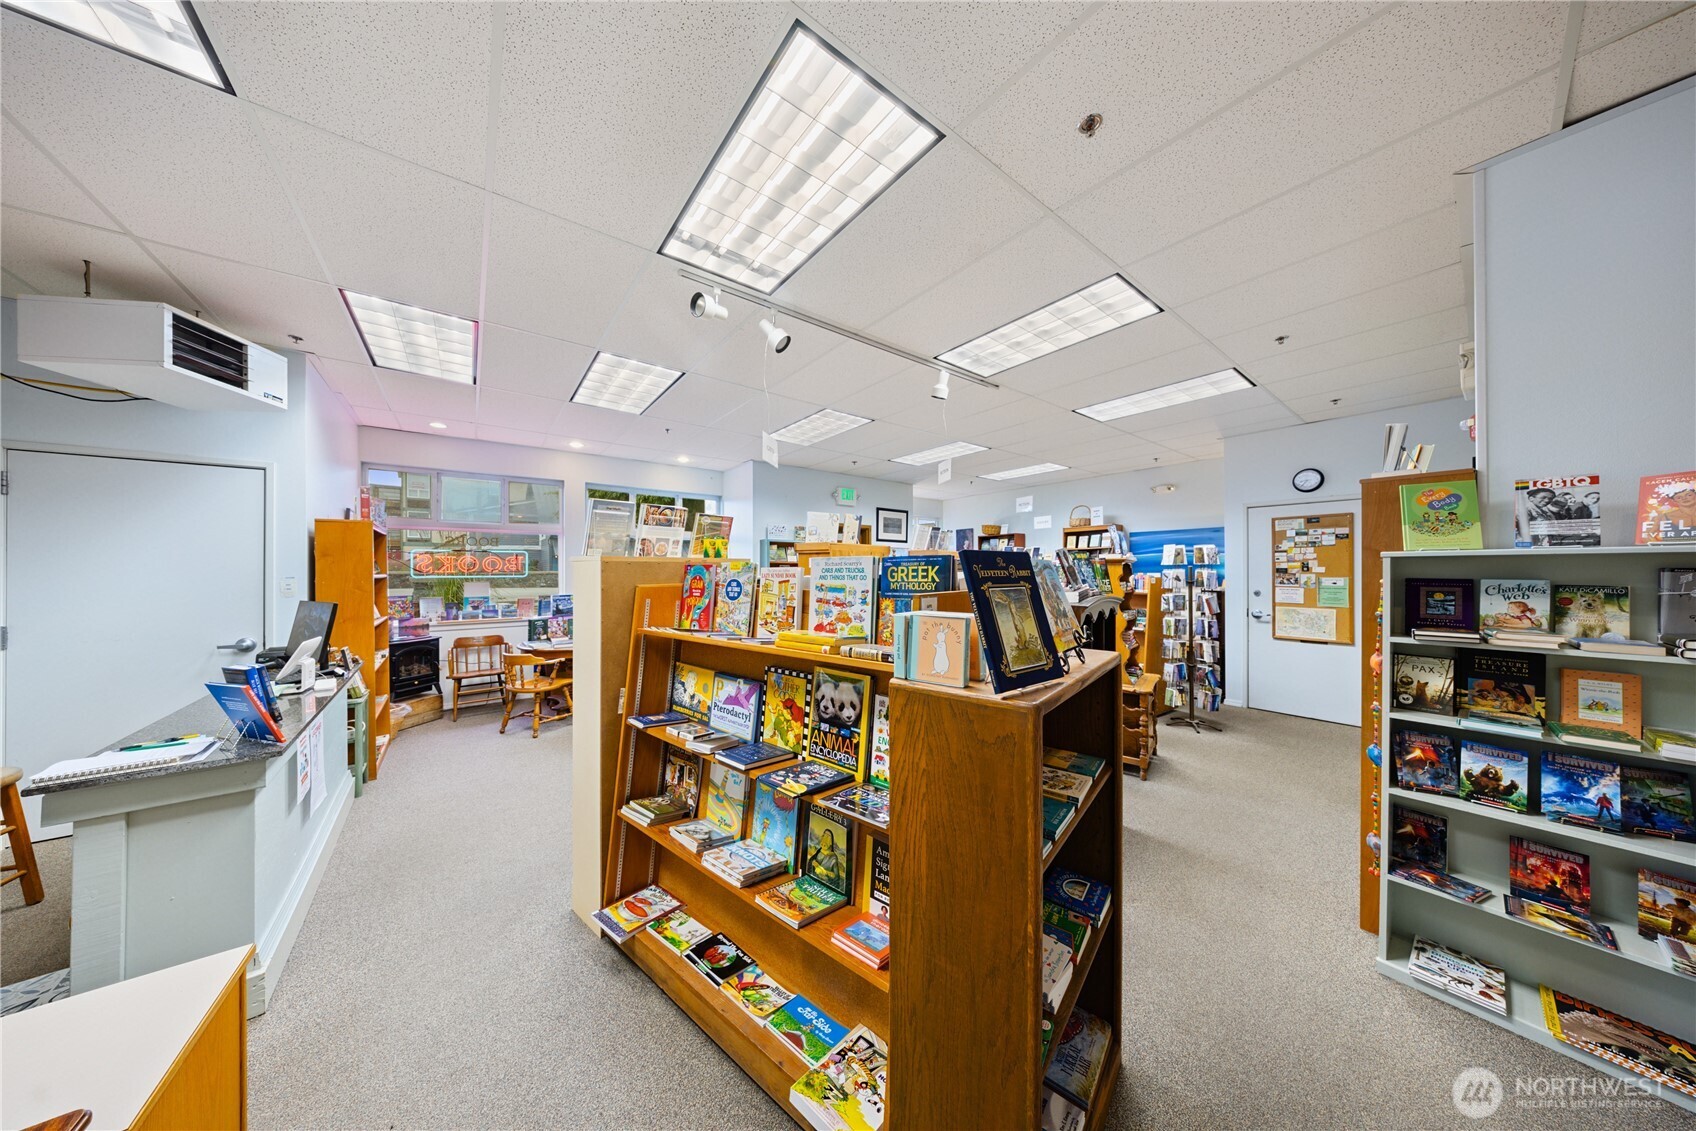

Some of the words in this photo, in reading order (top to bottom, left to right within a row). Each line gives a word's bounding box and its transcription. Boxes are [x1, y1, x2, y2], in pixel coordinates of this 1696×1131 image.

[1530, 476, 1590, 489] LGBTQ
[1421, 492, 1446, 502] Every
[1432, 497, 1456, 508] Body
[1642, 520, 1691, 532] FEL
[888, 566, 940, 582] GREEK
[890, 582, 936, 590] MYTHOLOGY
[1485, 583, 1548, 596] Charlotte's
[947, 622, 962, 644] bunny
[1412, 664, 1435, 674] PAX
[1474, 659, 1529, 668] TREASURE
[1475, 664, 1529, 673] ISLAND
[713, 702, 751, 723] Pterodactyl
[811, 730, 856, 757] ANIMAL
[878, 737, 889, 745] EN
[1411, 734, 1451, 746] SURVIVED
[810, 744, 856, 766] ENCYCLOPEDIA
[1473, 746, 1523, 762] SURVIVED
[1547, 752, 1552, 761] I
[1555, 755, 1613, 772] SURVIVED
[810, 804, 843, 823] GALLERY
[1404, 812, 1443, 826] SURVIVED
[724, 844, 772, 868] KNOTS
[876, 846, 889, 858] Am
[1523, 840, 1528, 849] I
[1529, 842, 1584, 864] SURVIVED
[876, 857, 889, 871] Sig
[875, 868, 889, 882] Lan
[1653, 875, 1696, 894] SURVI
[1431, 950, 1484, 974] Dinosaurs
[1431, 955, 1482, 977] Prehistoric
[798, 1007, 815, 1020] Far
[813, 1018, 832, 1033] Side
[1556, 991, 1696, 1054] Dinosau
[1075, 1056, 1092, 1077] HAIR
